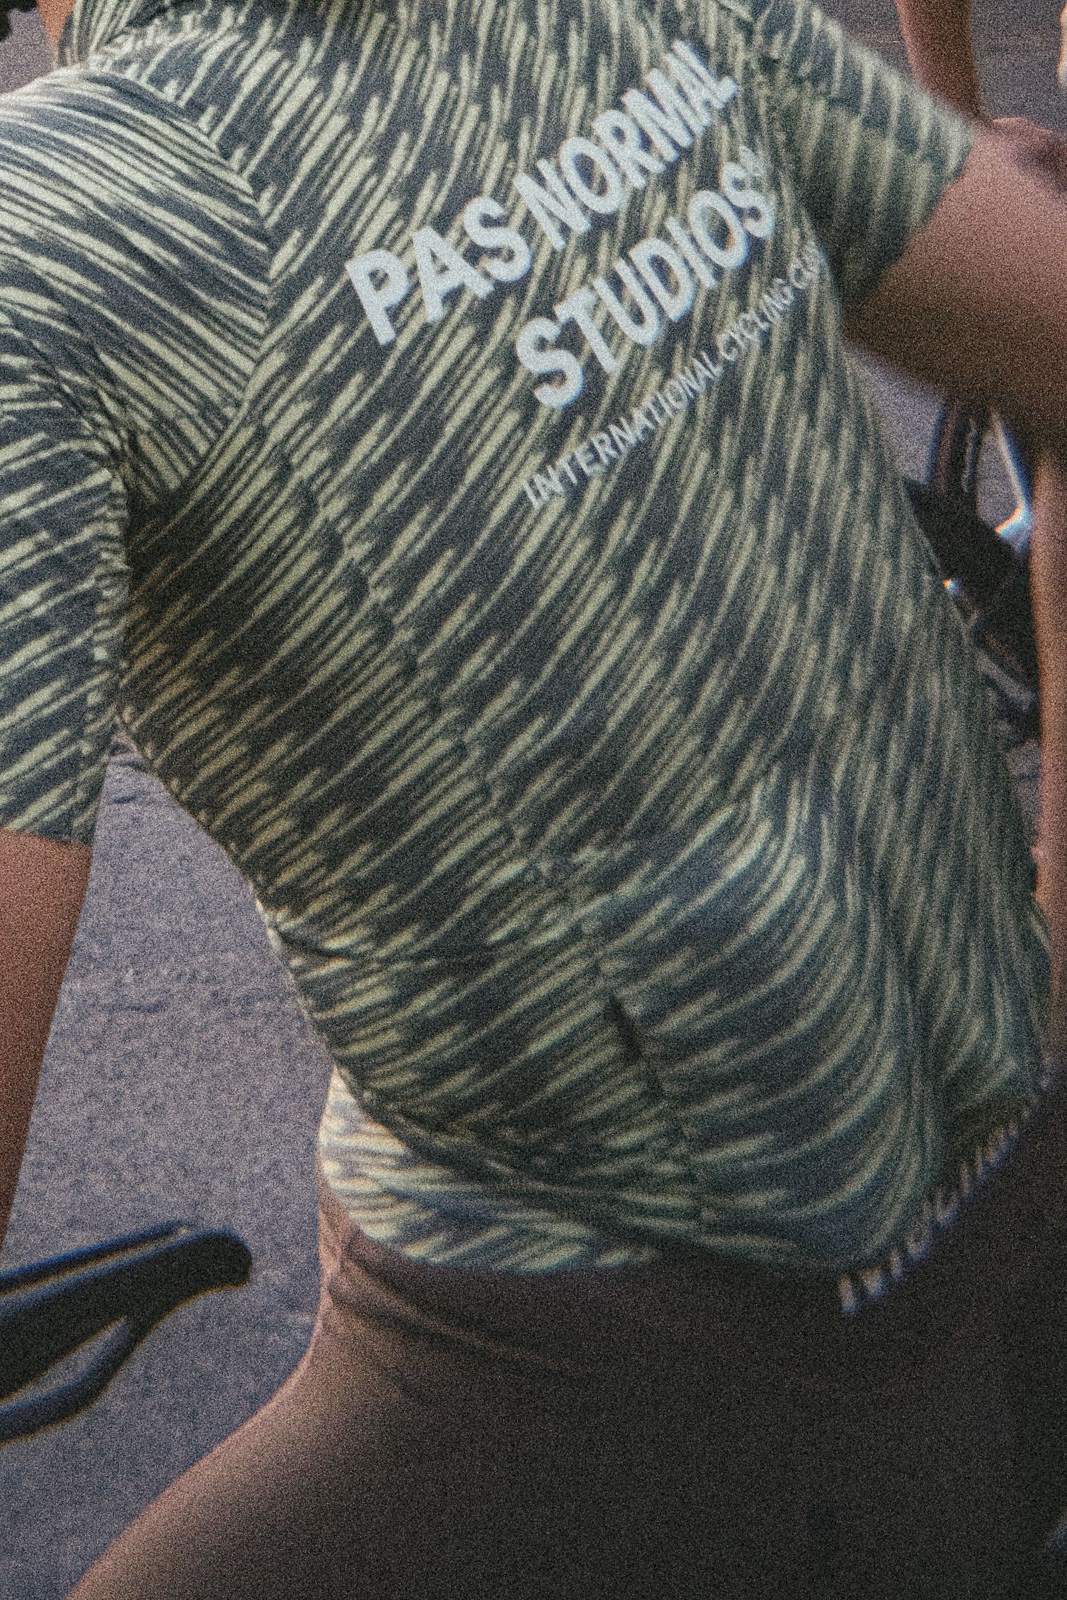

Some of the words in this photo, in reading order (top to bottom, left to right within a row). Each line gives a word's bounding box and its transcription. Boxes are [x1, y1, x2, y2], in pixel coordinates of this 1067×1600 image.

[345, 196, 532, 346] PAS
[514, 39, 738, 251] NORMAL
[521, 353, 723, 509] INTERNATIONAL
[715, 277, 796, 362] CYCLING
